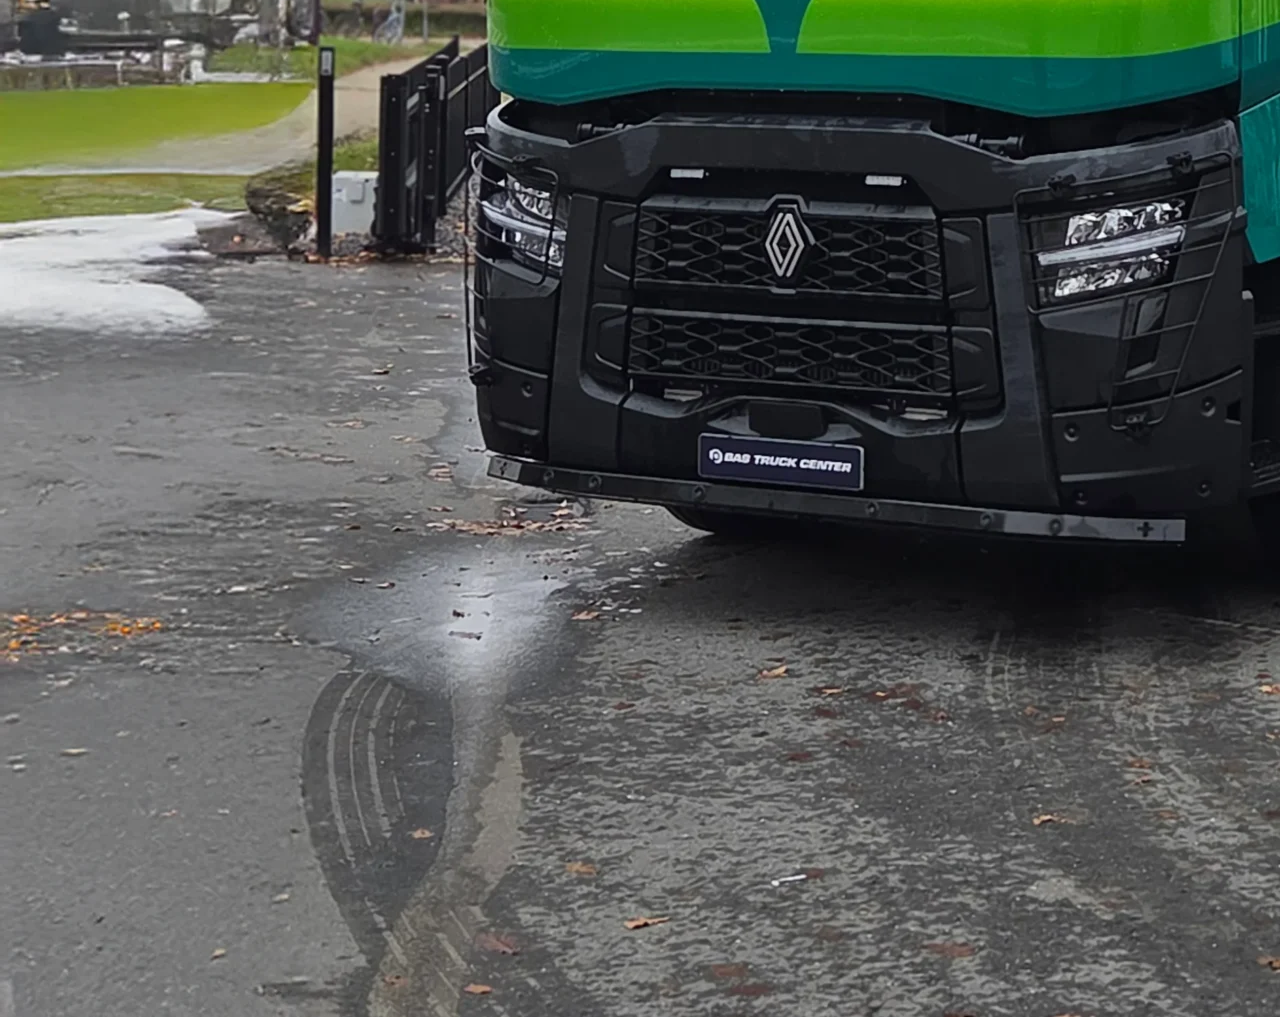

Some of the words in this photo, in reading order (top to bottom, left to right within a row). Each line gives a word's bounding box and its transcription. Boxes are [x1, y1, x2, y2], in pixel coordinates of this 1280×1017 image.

[724, 452, 751, 464] BAS
[753, 454, 797, 468] TRUCK
[799, 458, 852, 473] CENTER
